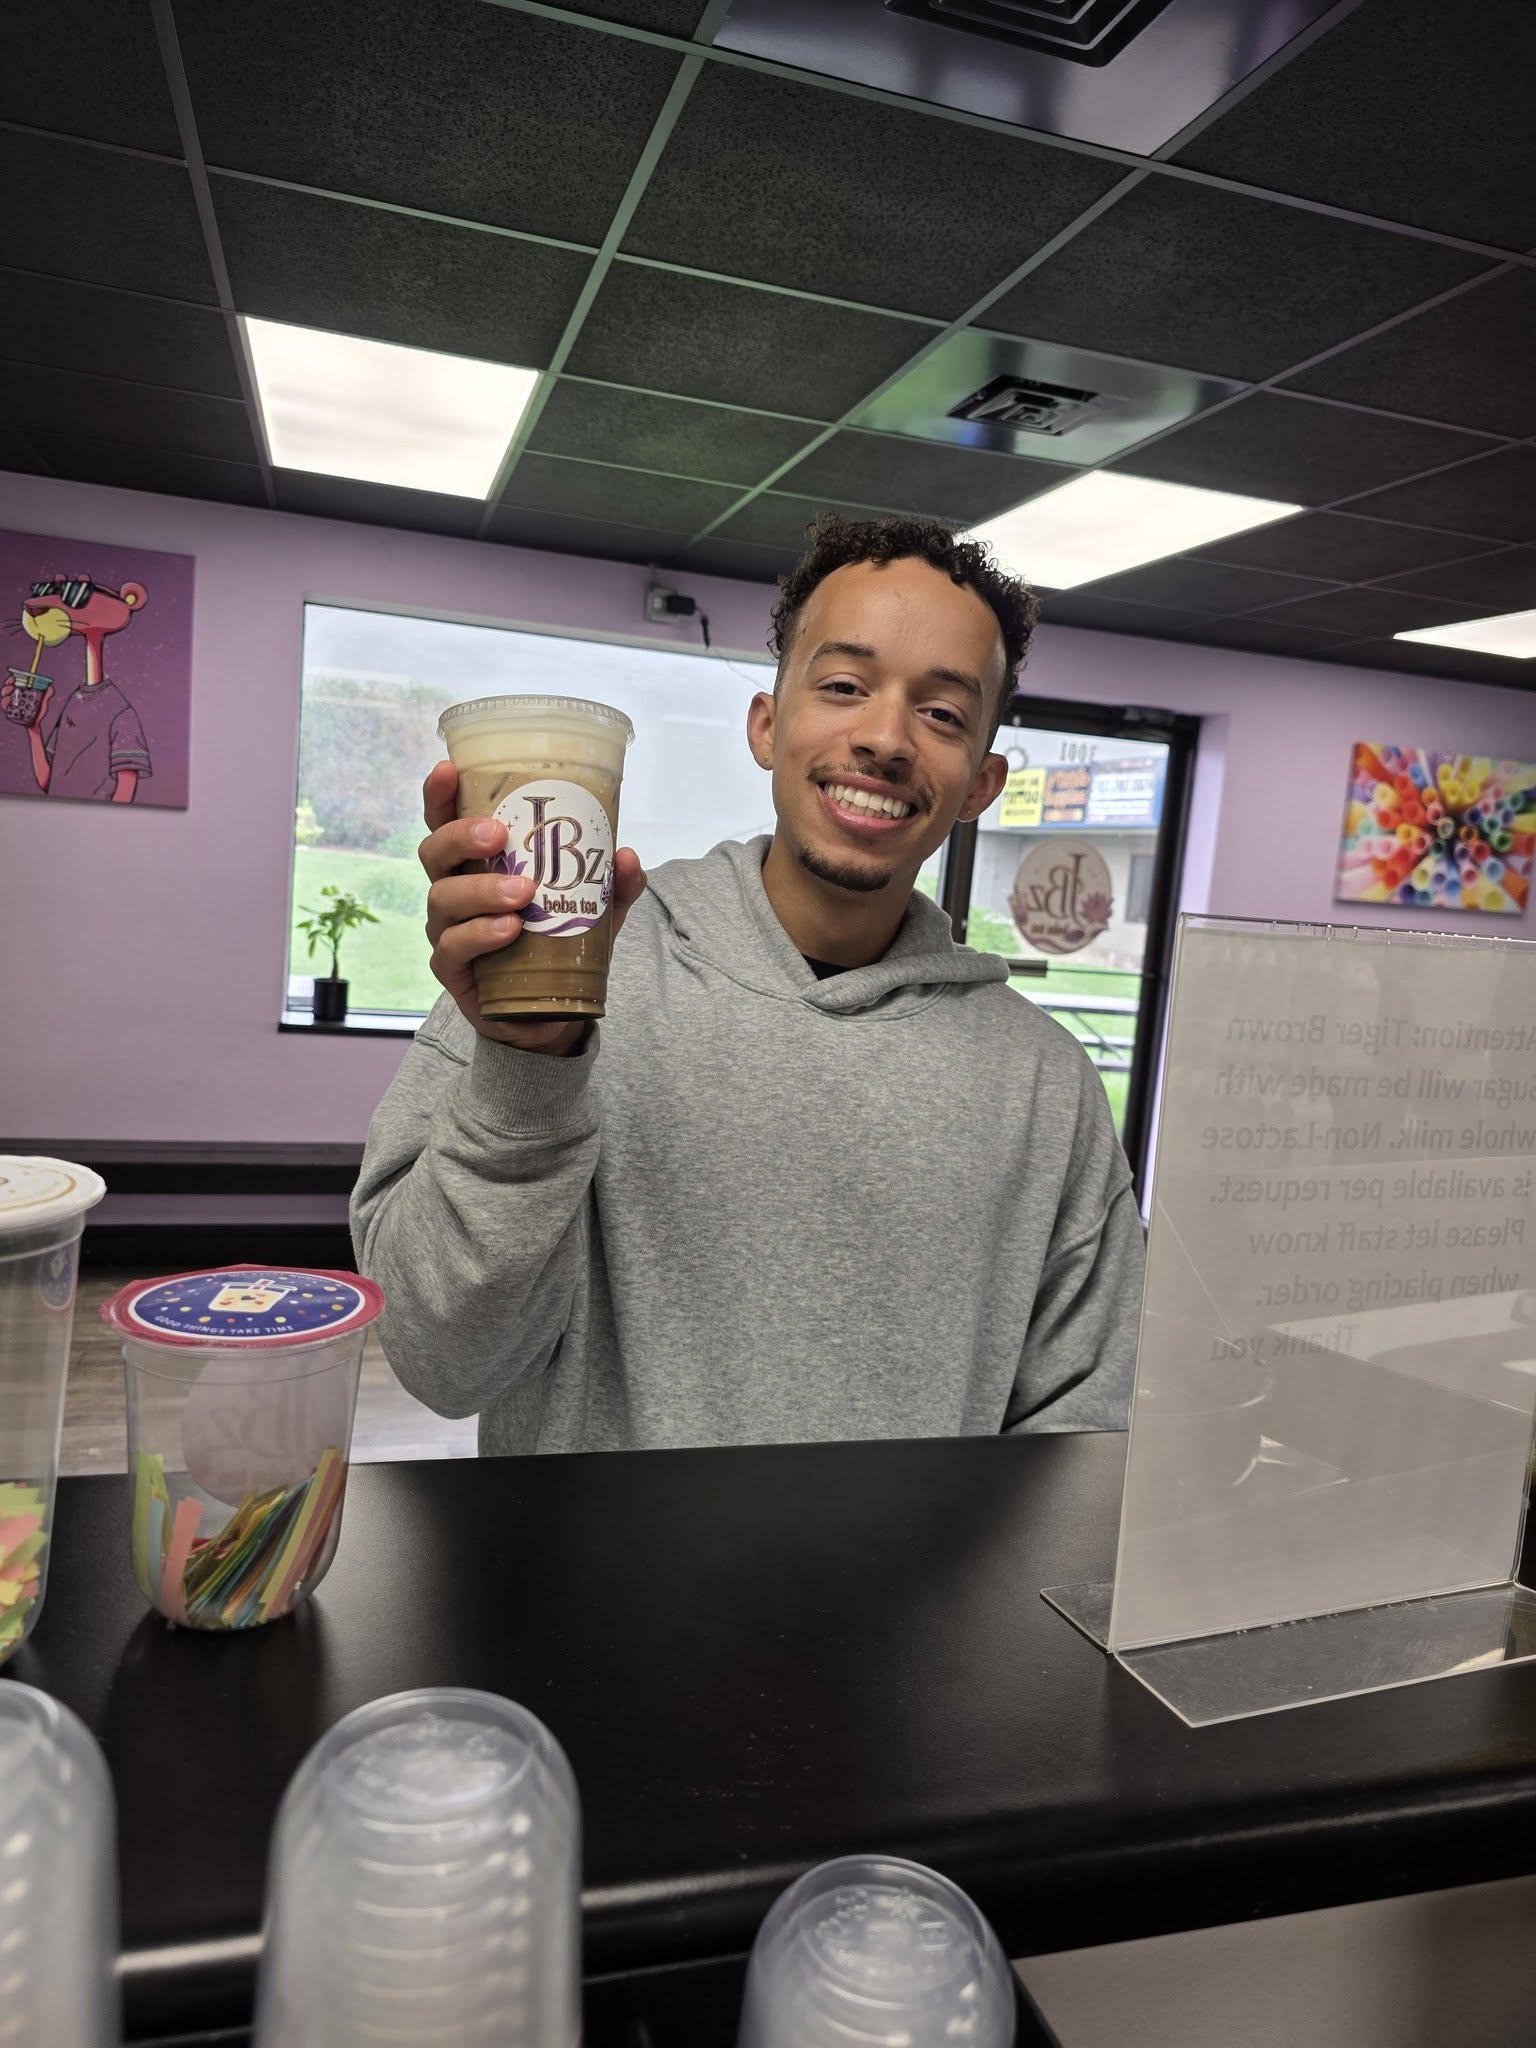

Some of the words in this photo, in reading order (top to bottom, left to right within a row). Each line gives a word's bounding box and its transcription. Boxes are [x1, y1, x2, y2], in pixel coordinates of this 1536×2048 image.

[543, 894, 578, 914] boba
[580, 897, 598, 915] tea
[155, 1315, 182, 1327] GOOD
[183, 1323, 226, 1334] THINGS
[230, 1327, 260, 1335] TAKE
[264, 1324, 294, 1334] TIME
